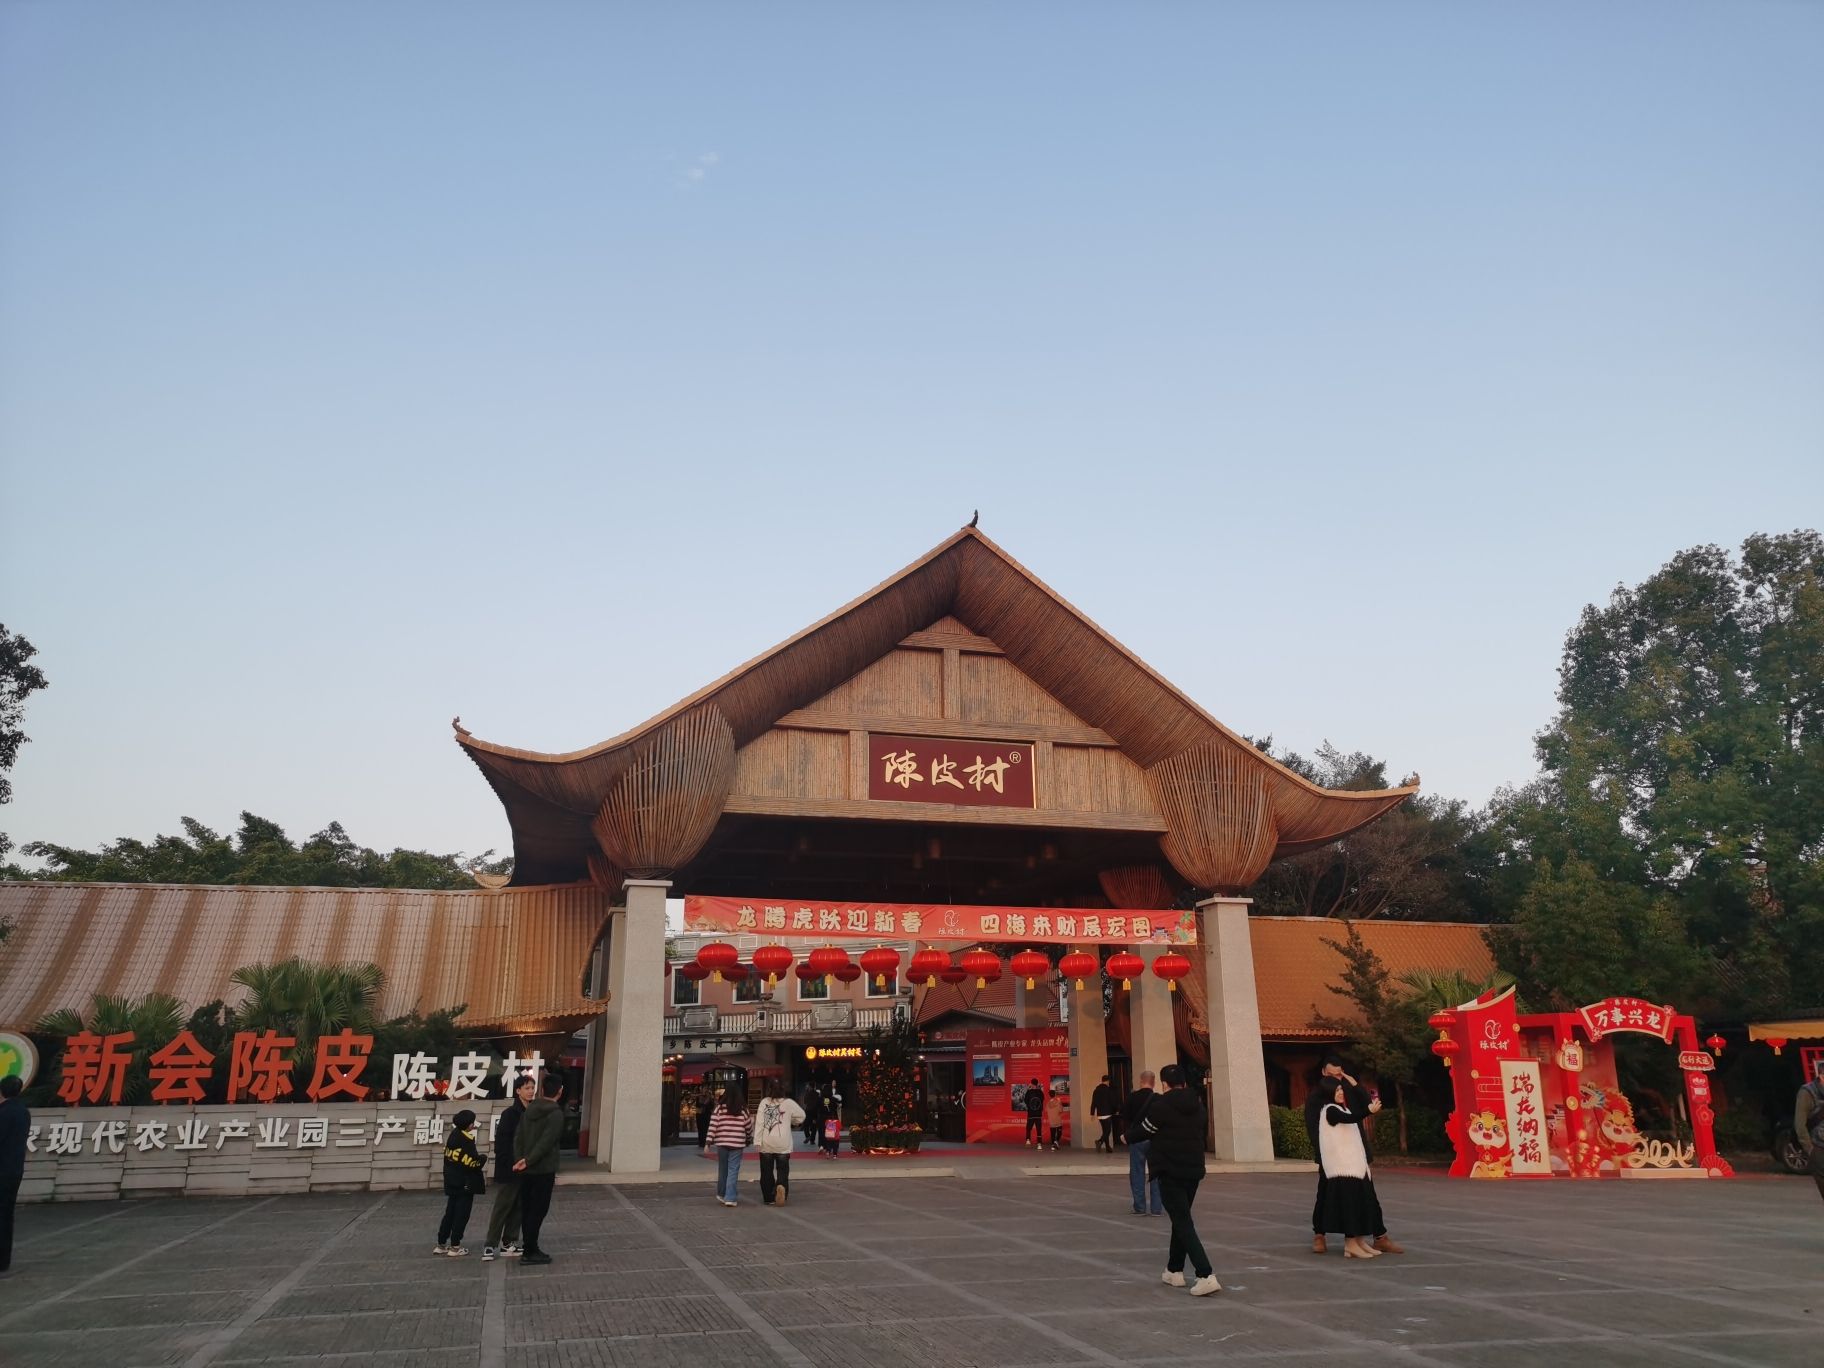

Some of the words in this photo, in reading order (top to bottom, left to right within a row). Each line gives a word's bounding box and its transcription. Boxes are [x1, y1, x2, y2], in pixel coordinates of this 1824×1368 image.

[736, 906, 923, 934] 龙腾虎跃迎新春
[980, 914, 1152, 938] 四海来财展宏图
[1595, 1007, 1661, 1029] 万事兴龙
[57, 1027, 374, 1104] 新会陈皮
[391, 1050, 545, 1100] 陈皮村
[1566, 1053, 1578, 1066] 福
[27, 1114, 501, 1154] 现代农业产业园三产融
[1628, 1140, 1695, 1168] 2024
